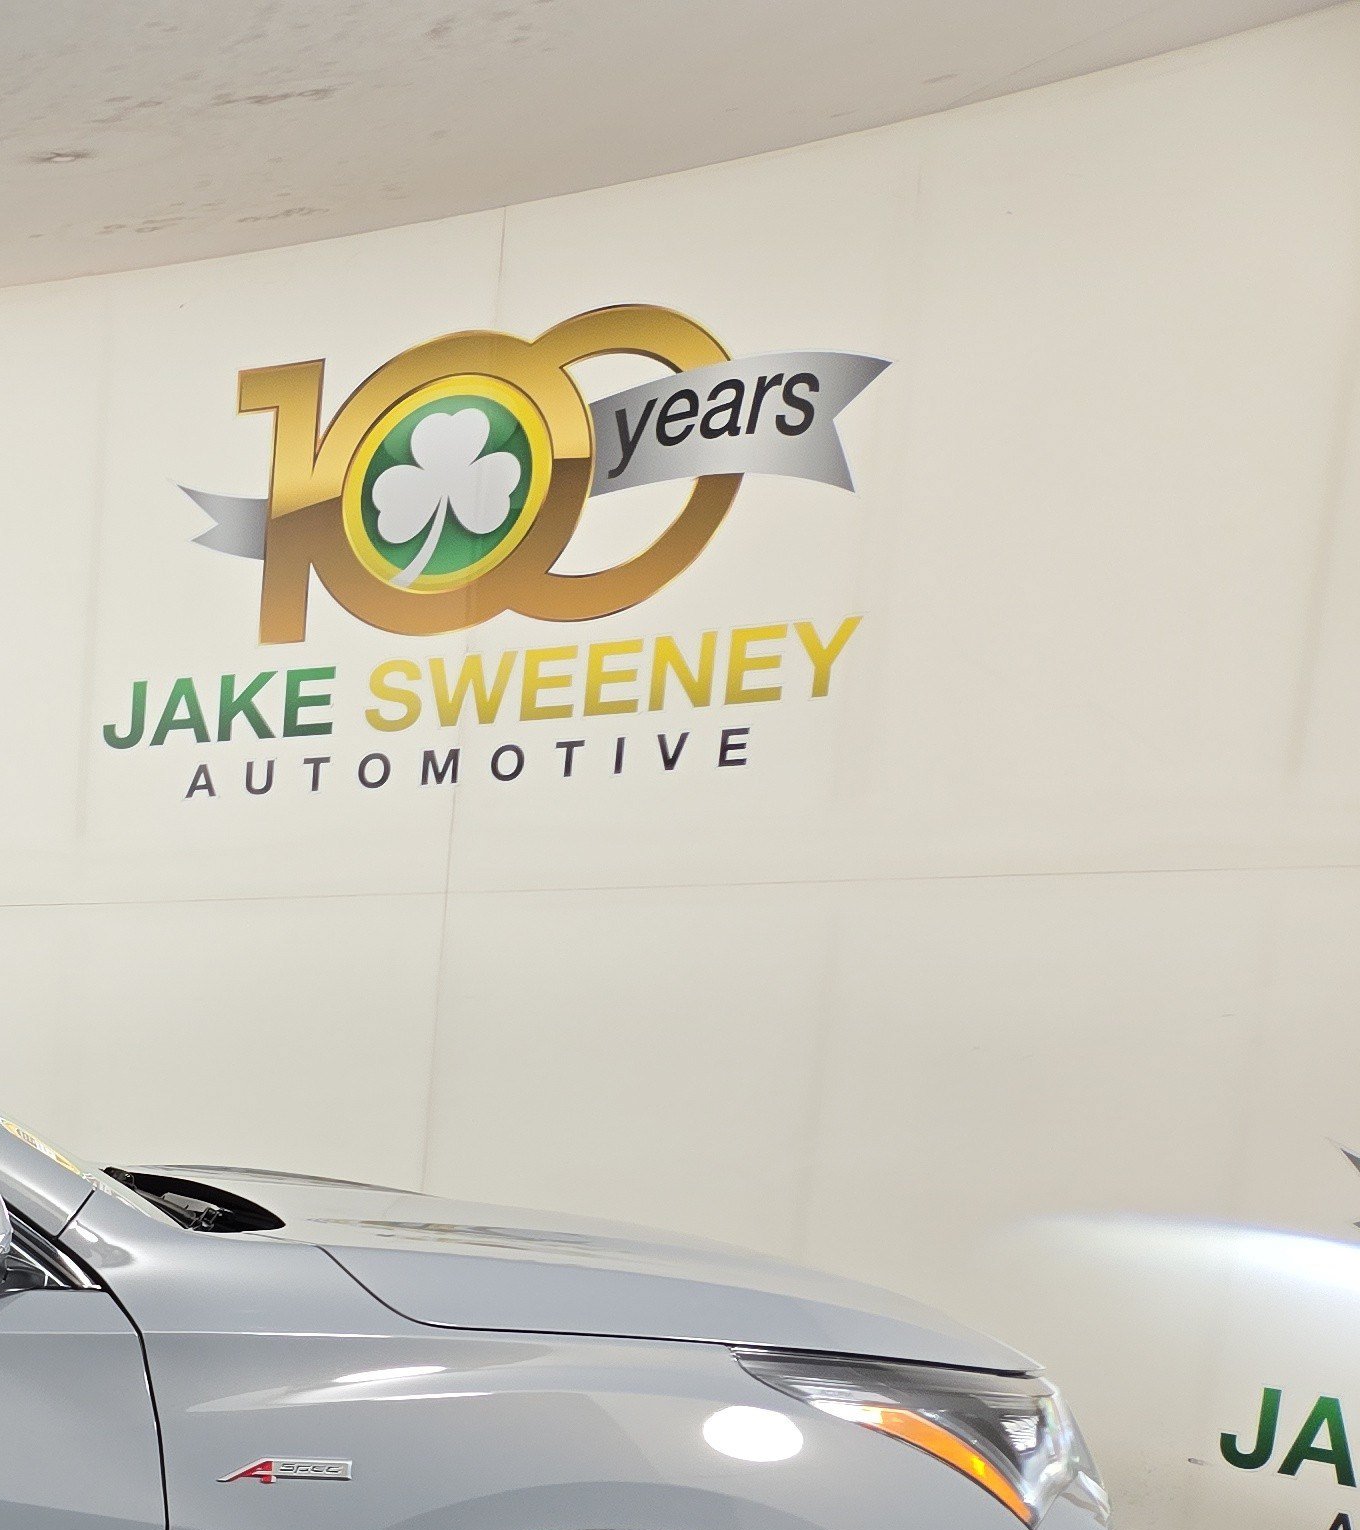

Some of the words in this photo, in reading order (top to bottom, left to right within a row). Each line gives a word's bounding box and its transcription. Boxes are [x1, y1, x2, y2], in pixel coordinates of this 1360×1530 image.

[237, 304, 744, 646] 100
[607, 371, 820, 479] years
[102, 665, 337, 750] JAKE
[365, 615, 863, 733] SWEENEY
[184, 727, 754, 799] AUTOMOTIVE
[1220, 1387, 1357, 1488] JA
